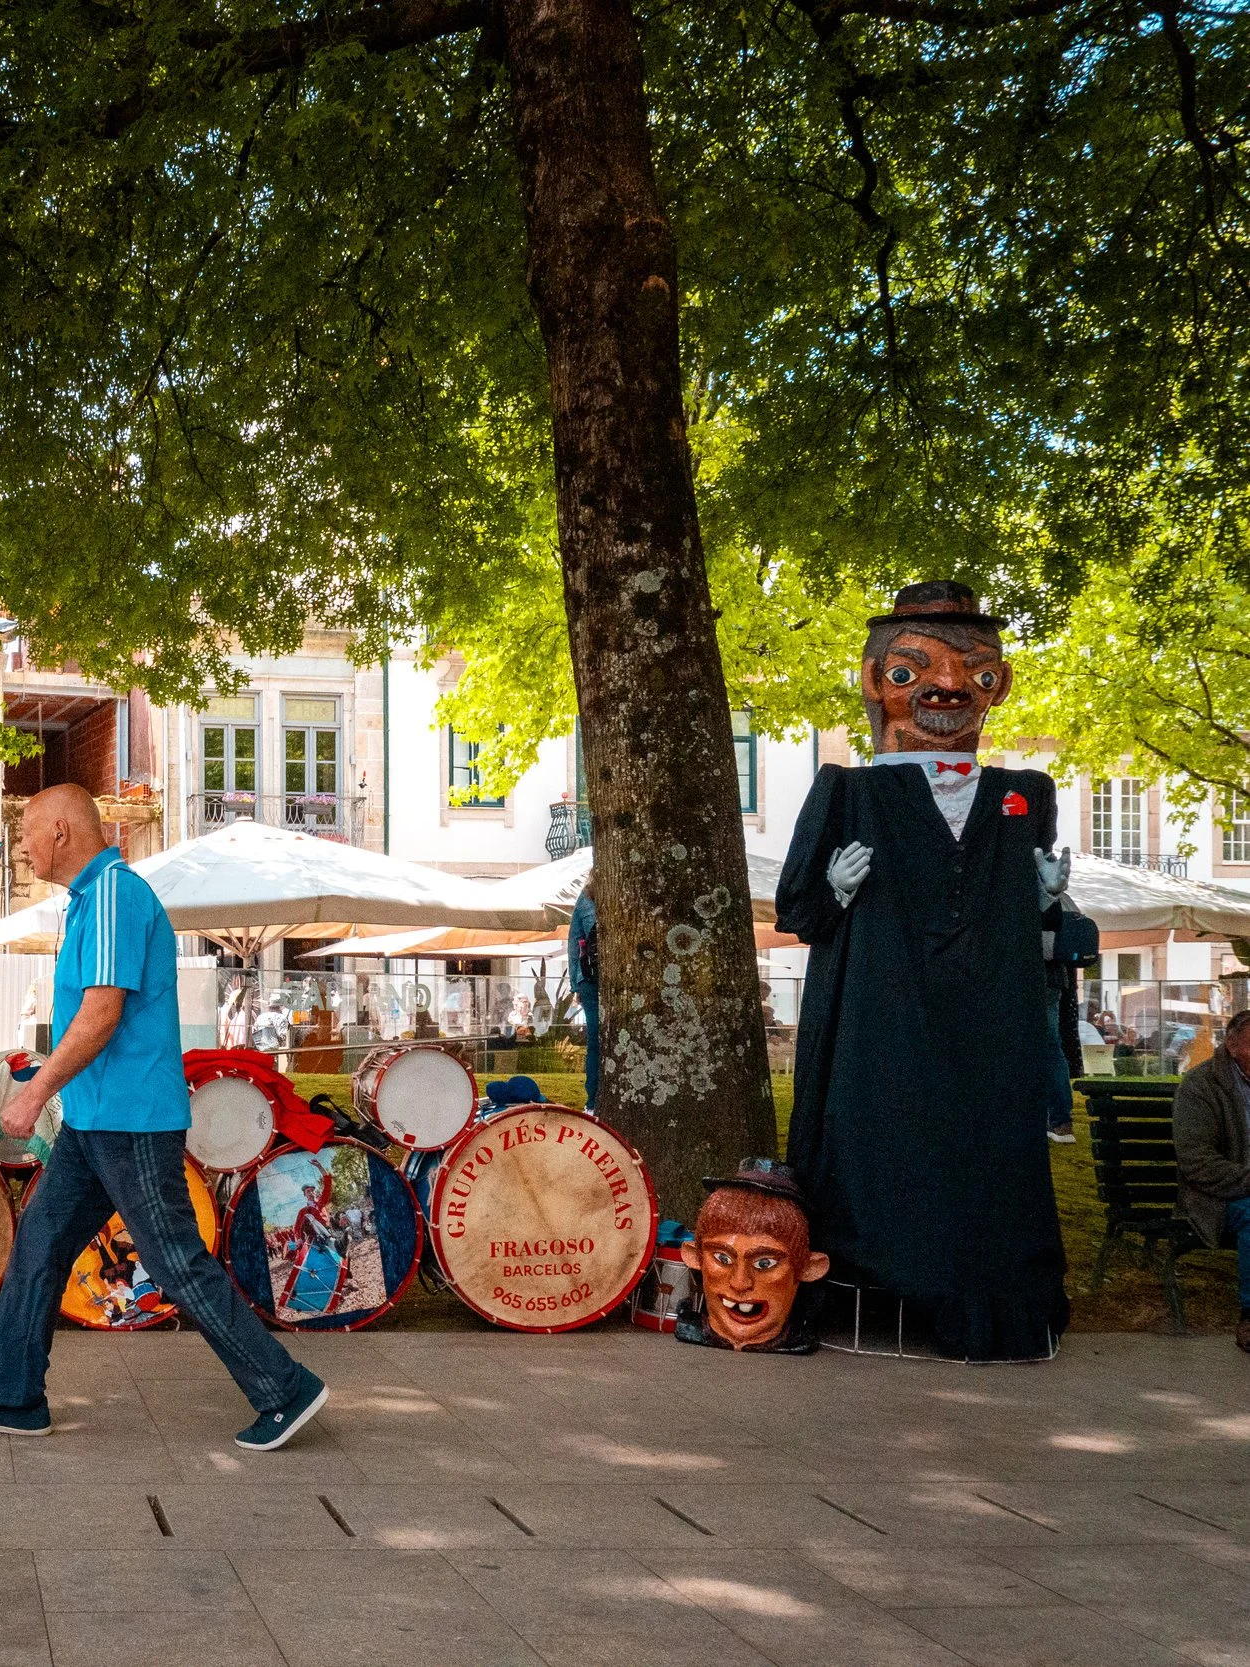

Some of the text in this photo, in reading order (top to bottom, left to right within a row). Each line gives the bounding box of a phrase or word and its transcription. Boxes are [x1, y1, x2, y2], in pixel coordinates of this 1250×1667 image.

[447, 1146, 494, 1239] GRUPO
[498, 1119, 547, 1152] ZÉS
[489, 1237, 595, 1258] FRAGOSO
[503, 1262, 582, 1277] BARCELOS
[492, 1282, 594, 1312] 965 655 602
